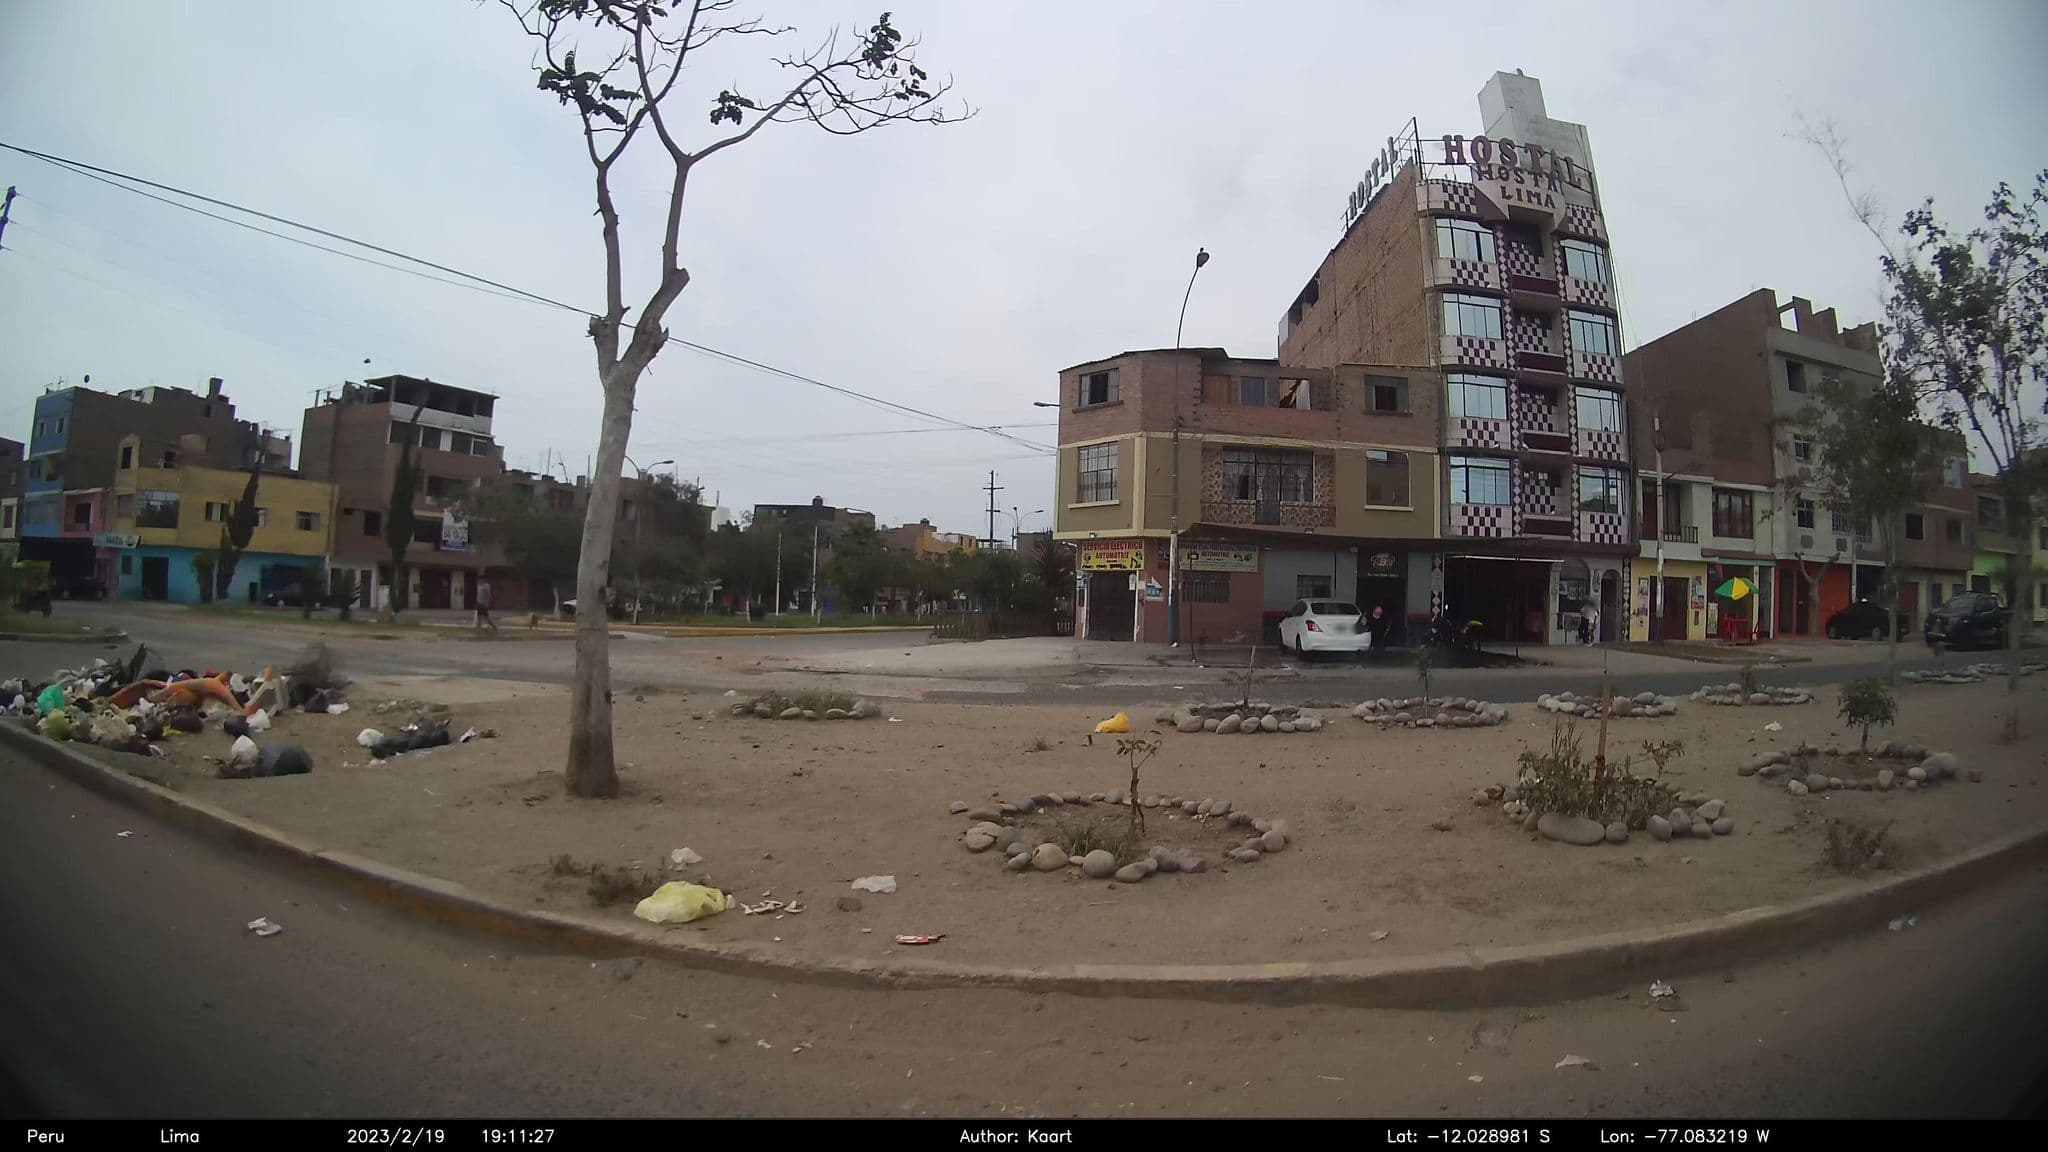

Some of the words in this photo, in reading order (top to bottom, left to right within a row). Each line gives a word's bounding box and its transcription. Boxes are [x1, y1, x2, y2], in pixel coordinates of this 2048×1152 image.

[1348, 136, 1398, 220] HOSTAL
[1442, 134, 1582, 189] HOSTAL
[1500, 185, 1556, 209] LIMA
